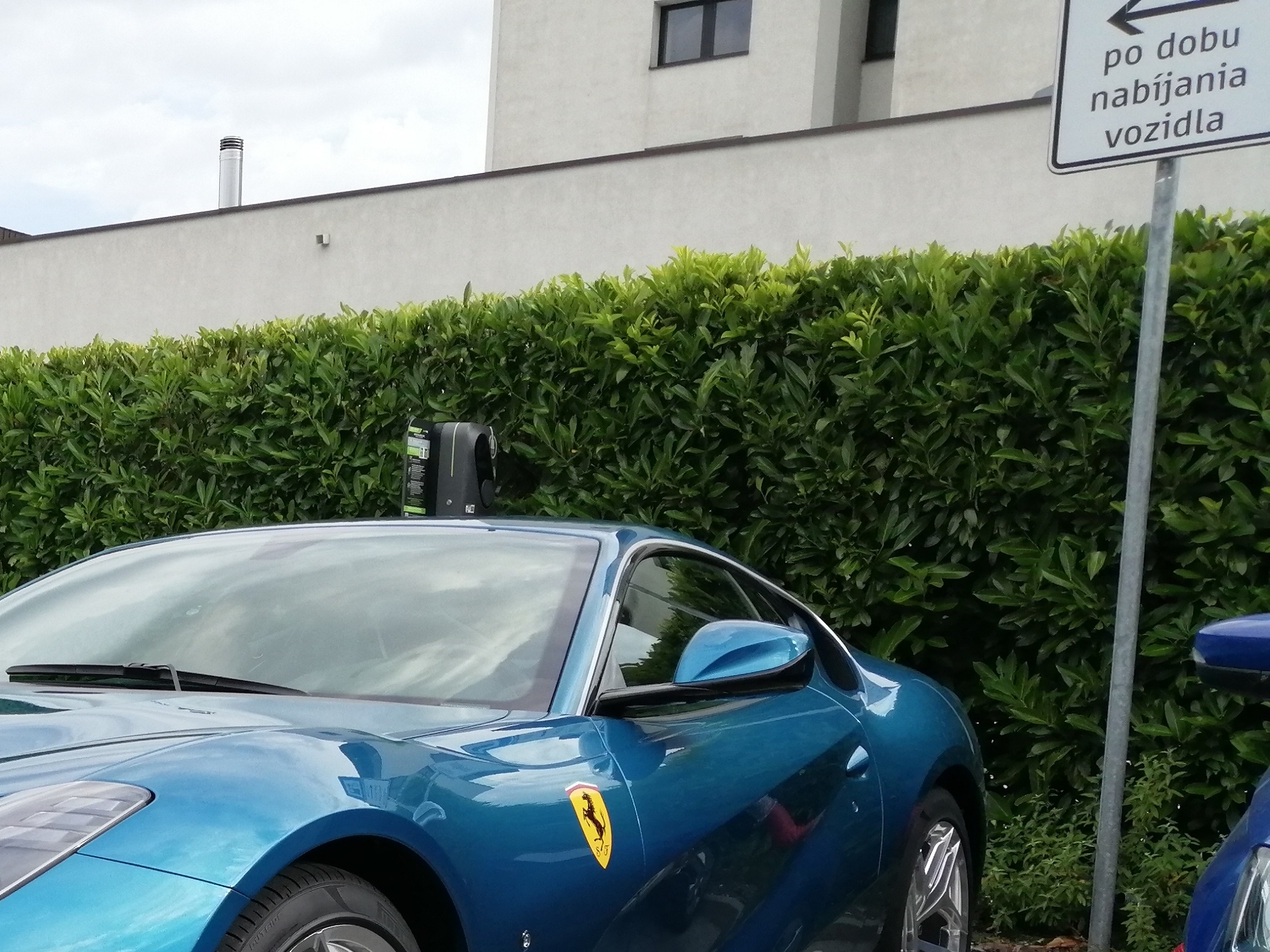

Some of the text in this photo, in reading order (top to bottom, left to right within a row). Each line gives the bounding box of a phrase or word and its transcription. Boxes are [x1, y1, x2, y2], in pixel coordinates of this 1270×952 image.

[1104, 26, 1241, 76] po dobu
[1090, 62, 1247, 112] nabíjania
[1104, 108, 1224, 148] vozidla
